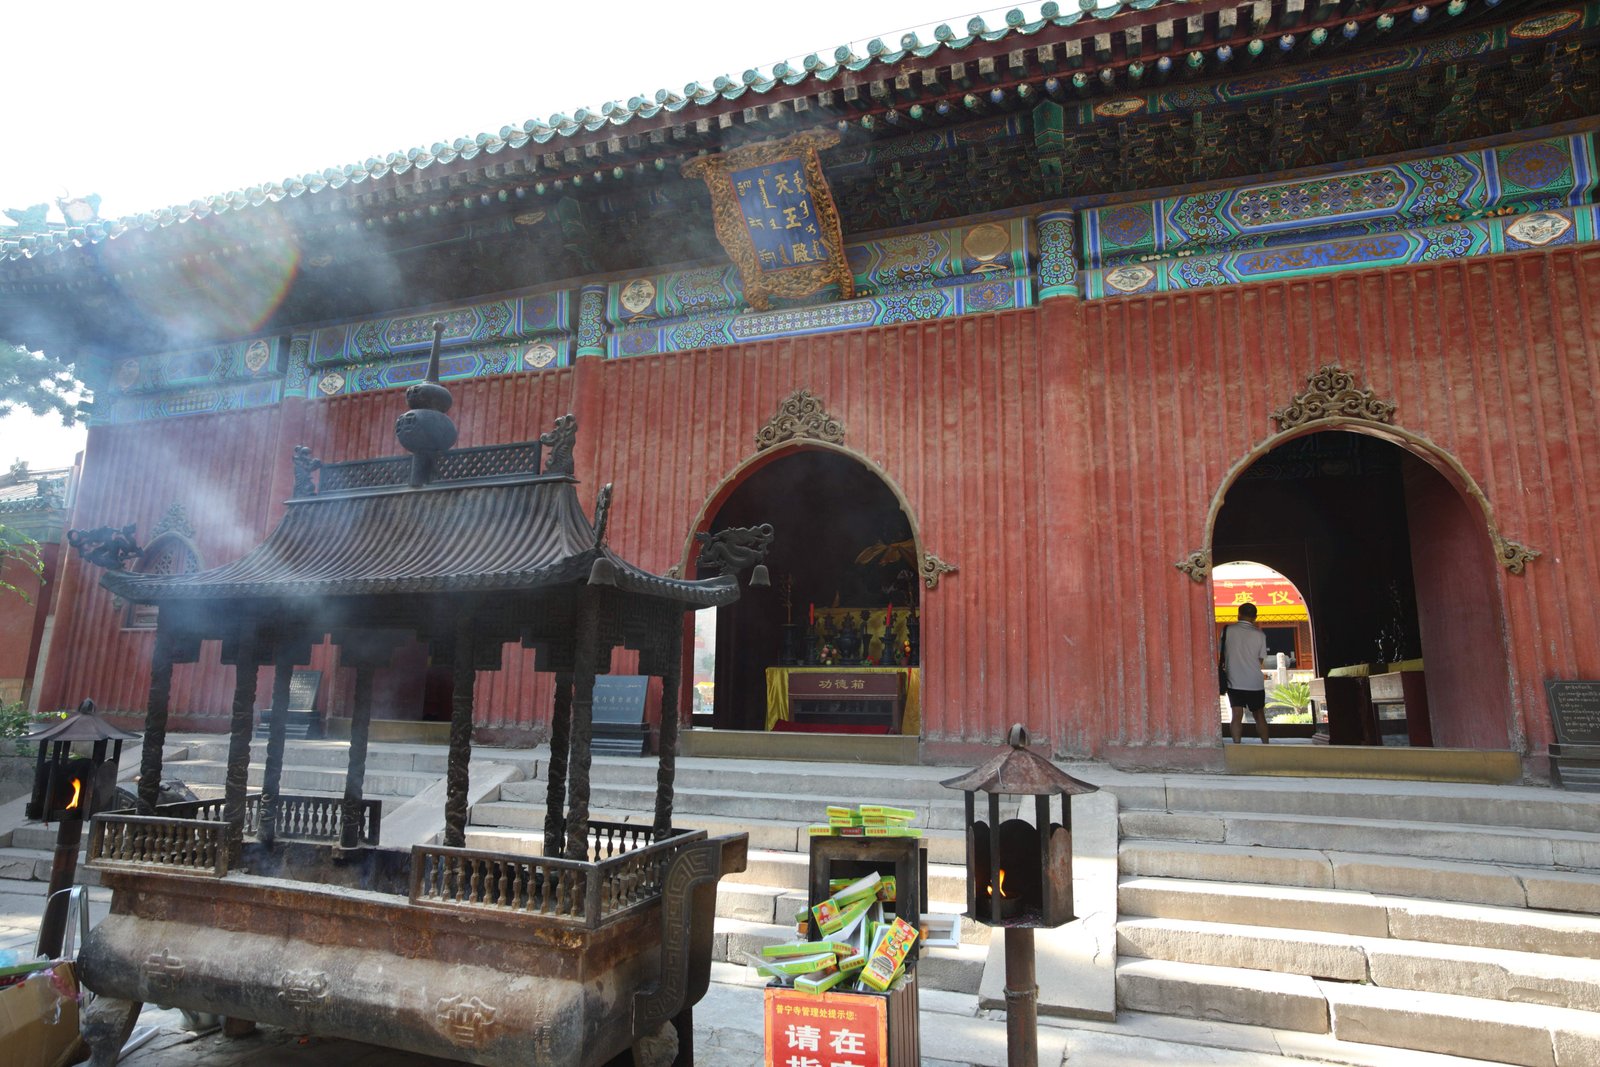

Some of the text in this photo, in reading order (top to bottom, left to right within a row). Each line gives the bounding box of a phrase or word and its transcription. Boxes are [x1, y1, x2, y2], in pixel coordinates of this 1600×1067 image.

[774, 173, 814, 264] 天王殿
[818, 679, 866, 689] 功德箱
[784, 1024, 866, 1055] 请在
